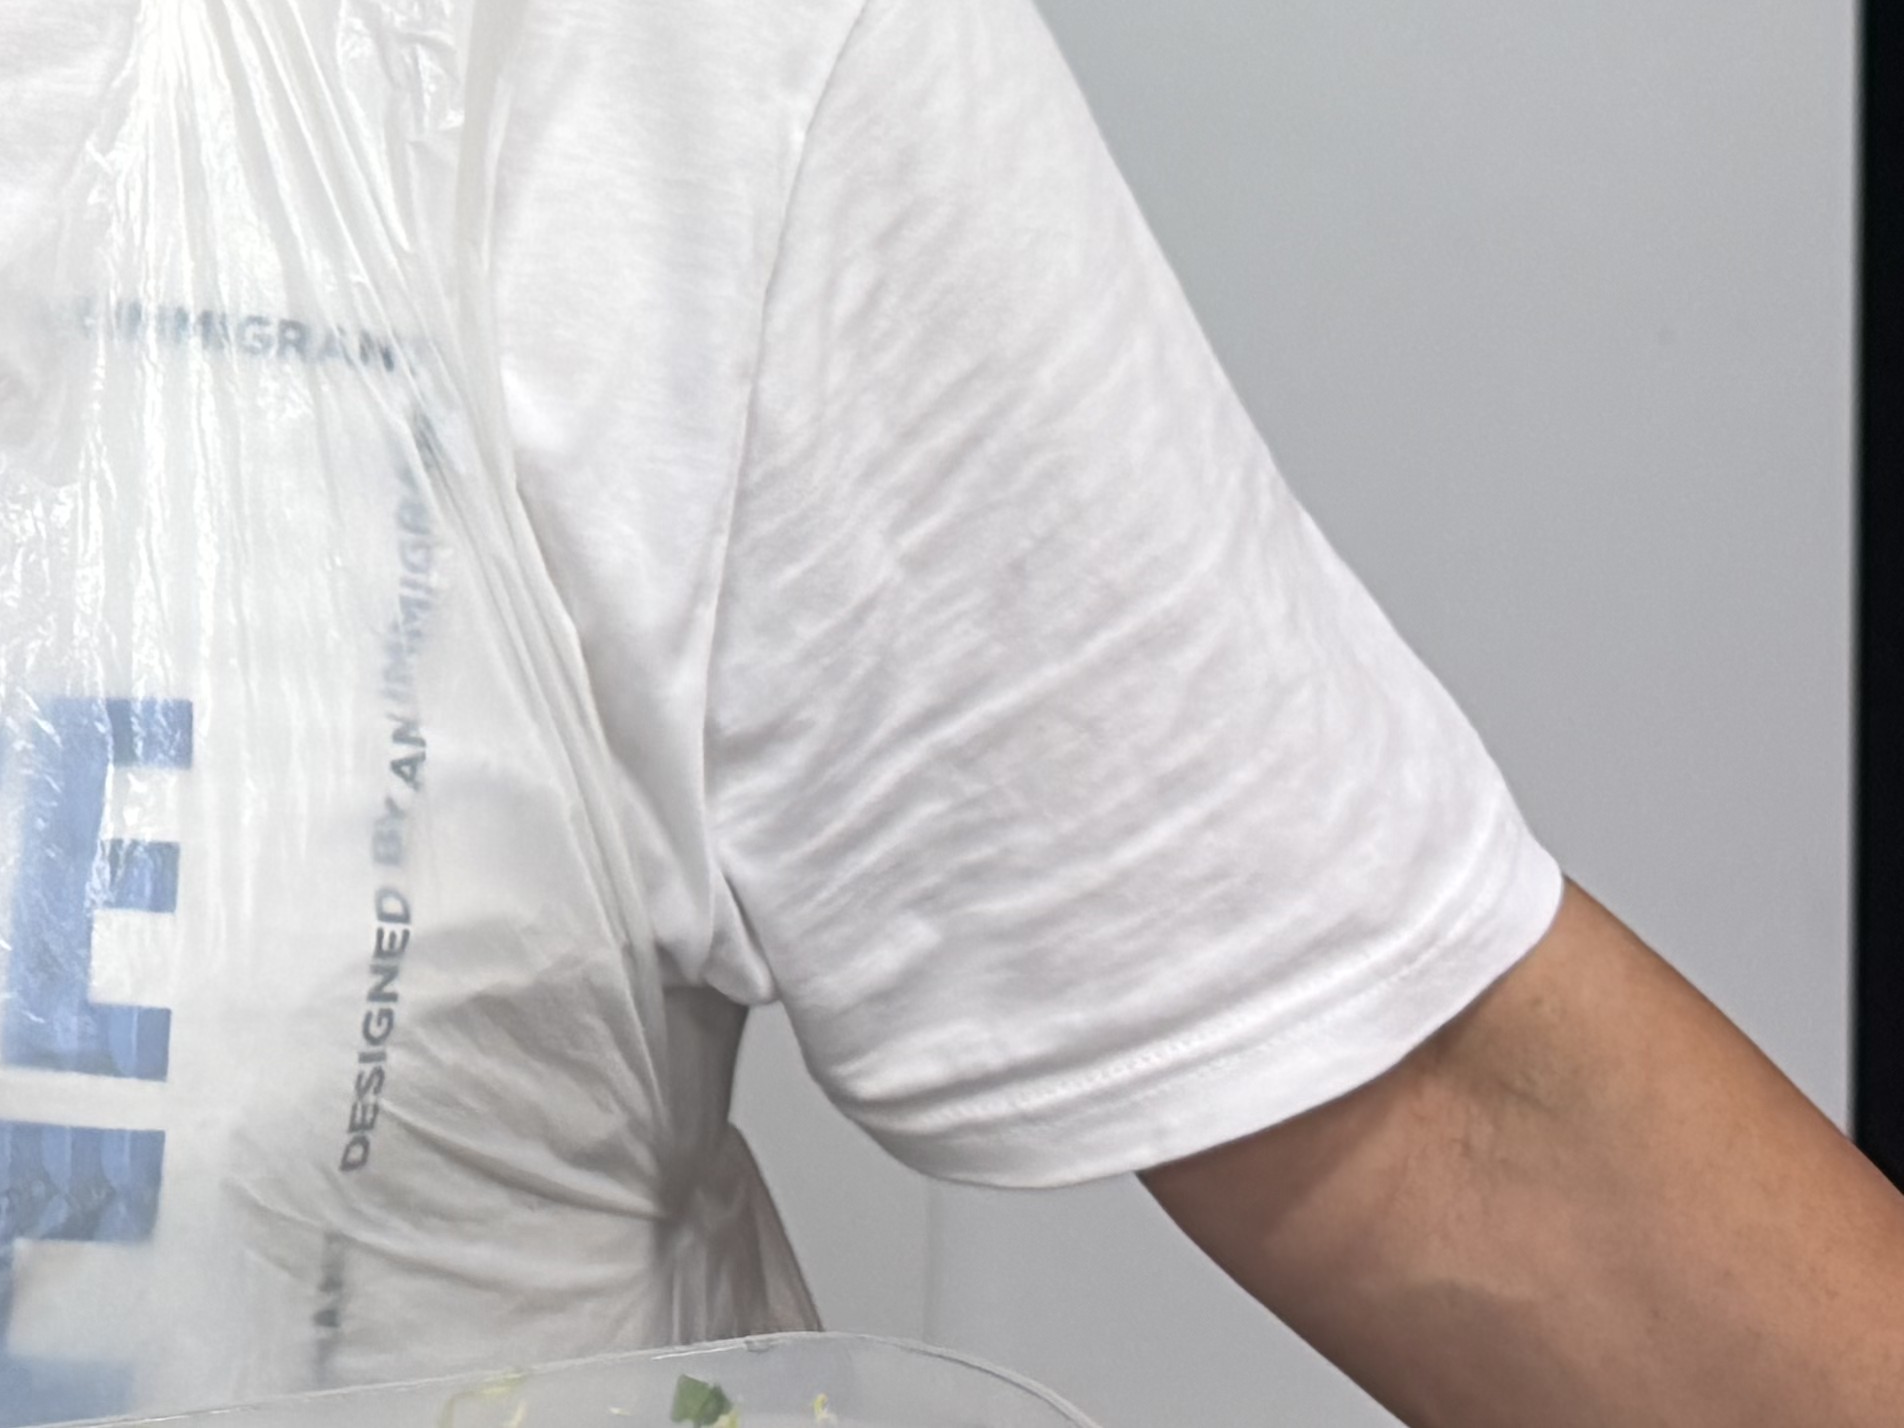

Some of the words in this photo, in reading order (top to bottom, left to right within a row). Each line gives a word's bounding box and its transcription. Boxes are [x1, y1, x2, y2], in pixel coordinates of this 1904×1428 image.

[386, 711, 428, 792] AN
[370, 794, 407, 867] BY
[338, 885, 411, 1173] DESIGNED
